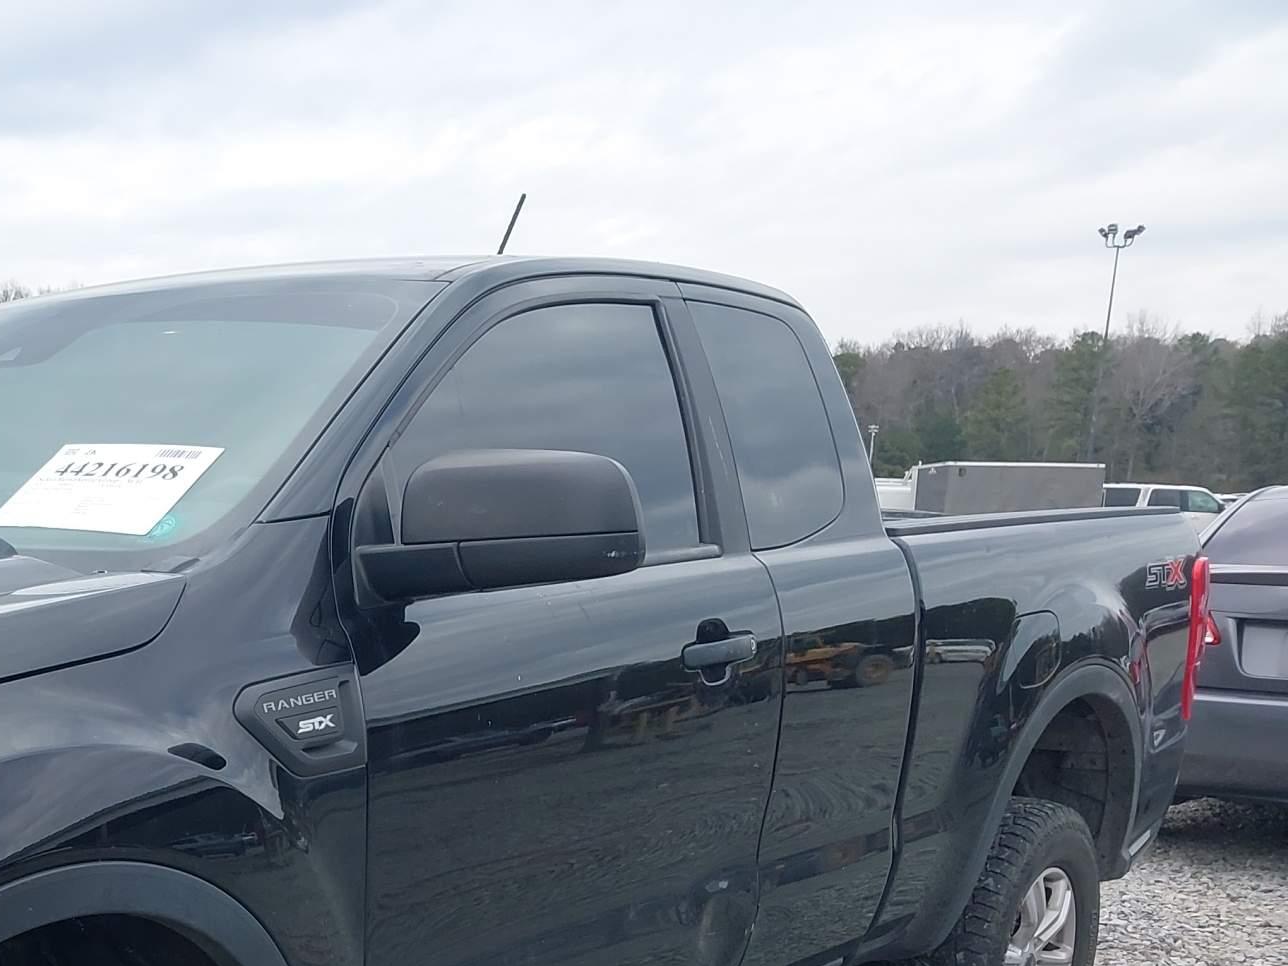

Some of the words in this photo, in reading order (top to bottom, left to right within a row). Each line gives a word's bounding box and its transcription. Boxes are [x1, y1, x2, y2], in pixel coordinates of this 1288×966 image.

[56, 462, 184, 480] 44216198
[1146, 559, 1187, 589] STX
[263, 689, 337, 713] RANGER
[297, 714, 336, 734] STX
